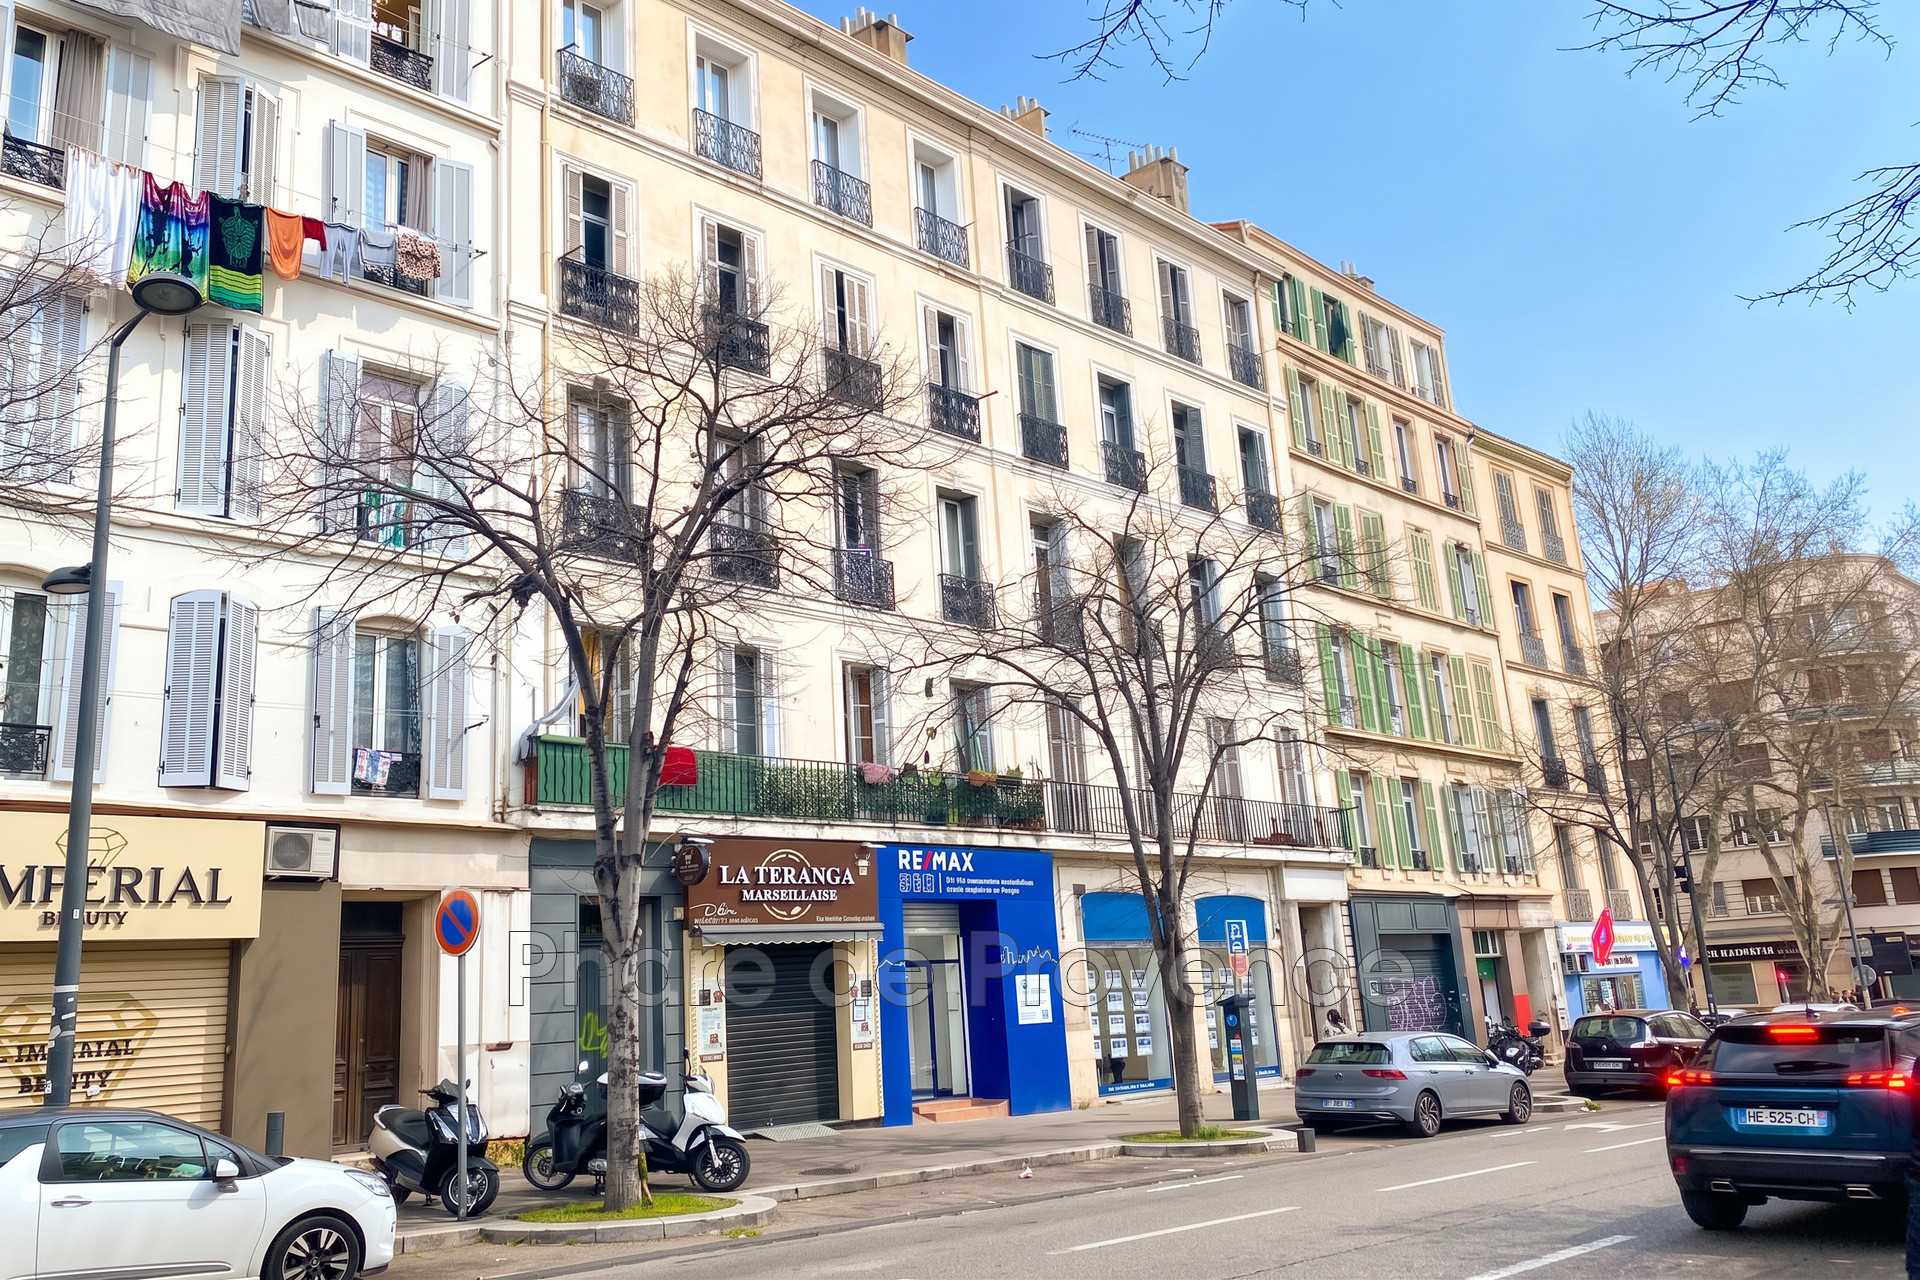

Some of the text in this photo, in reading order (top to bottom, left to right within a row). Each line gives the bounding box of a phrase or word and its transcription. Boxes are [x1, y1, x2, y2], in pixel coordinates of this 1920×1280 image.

[898, 850, 974, 872] RE/MAX
[719, 865, 750, 884] LA
[755, 866, 855, 885] TERANGA
[741, 889, 838, 902] MARSEILLAISE
